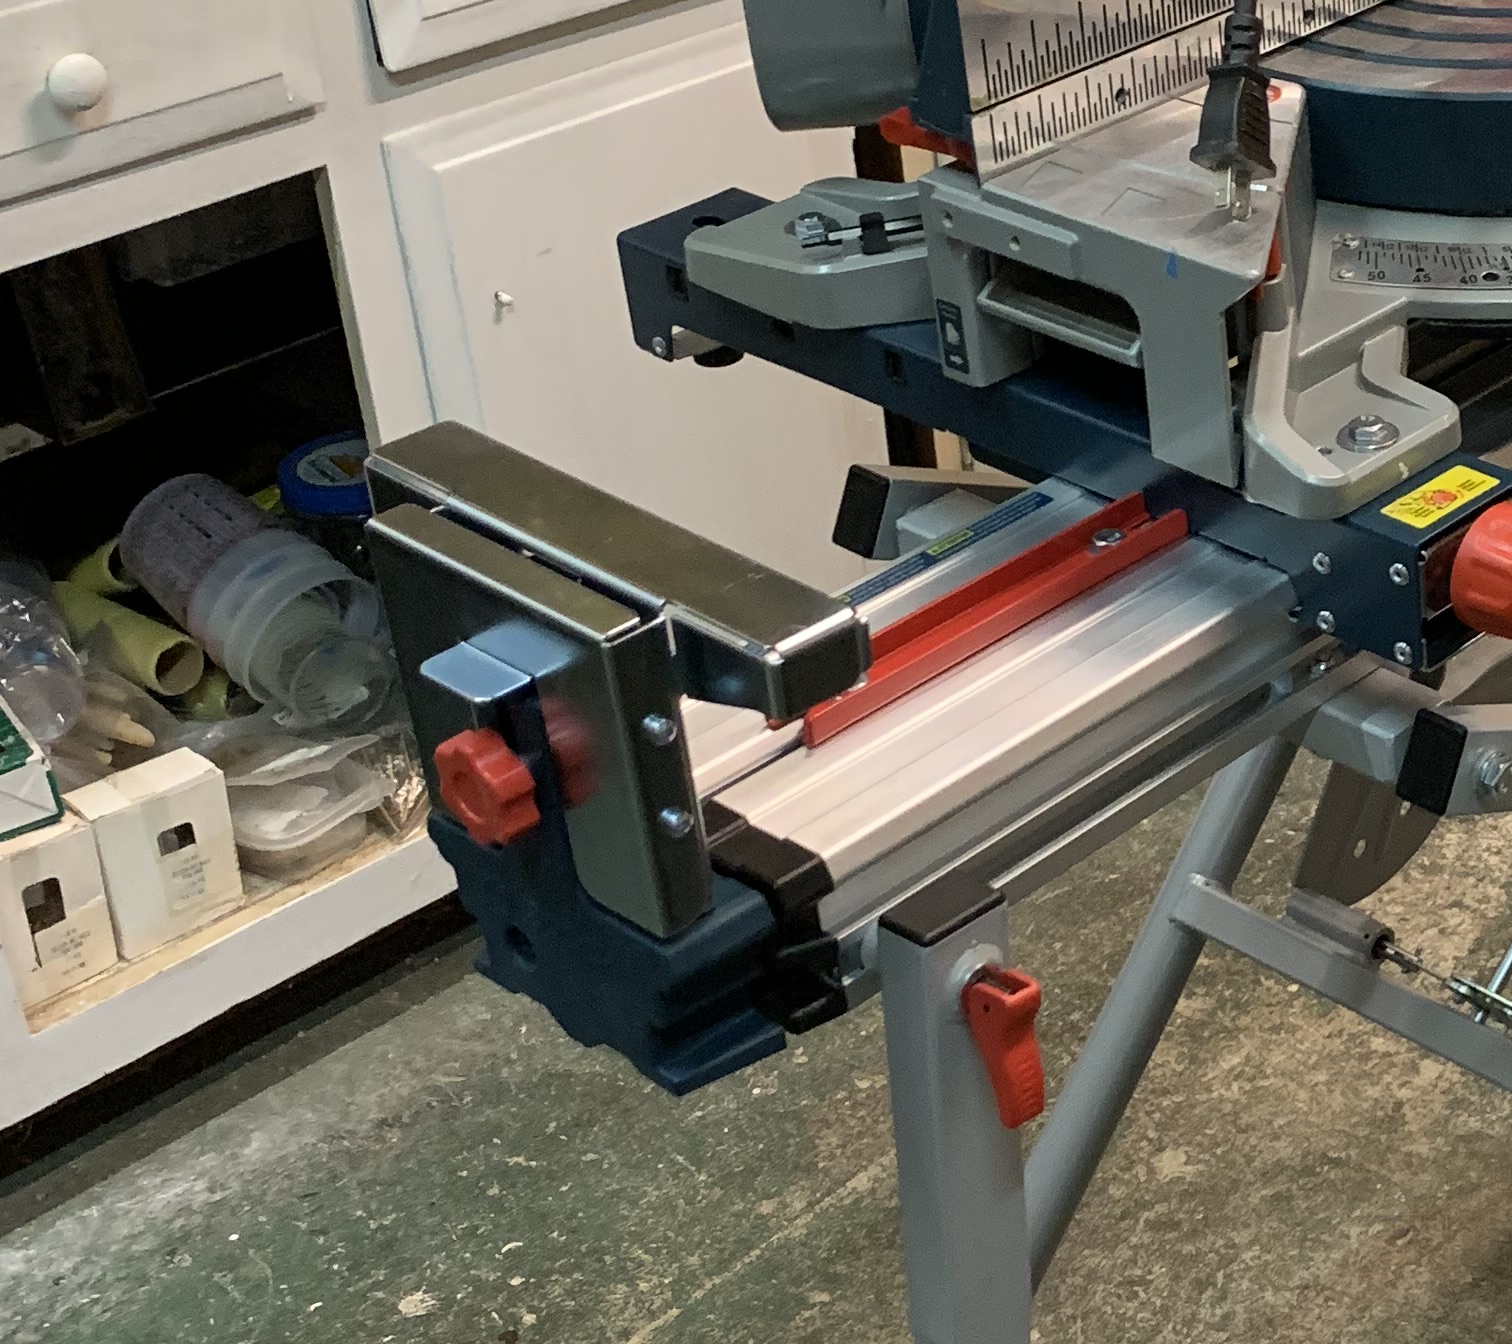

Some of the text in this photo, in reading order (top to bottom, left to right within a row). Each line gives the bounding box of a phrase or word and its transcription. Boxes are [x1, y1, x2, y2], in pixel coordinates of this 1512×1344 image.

[1367, 270, 1386, 281] 50
[1412, 272, 1432, 283] 45
[1460, 274, 1478, 285] 40
